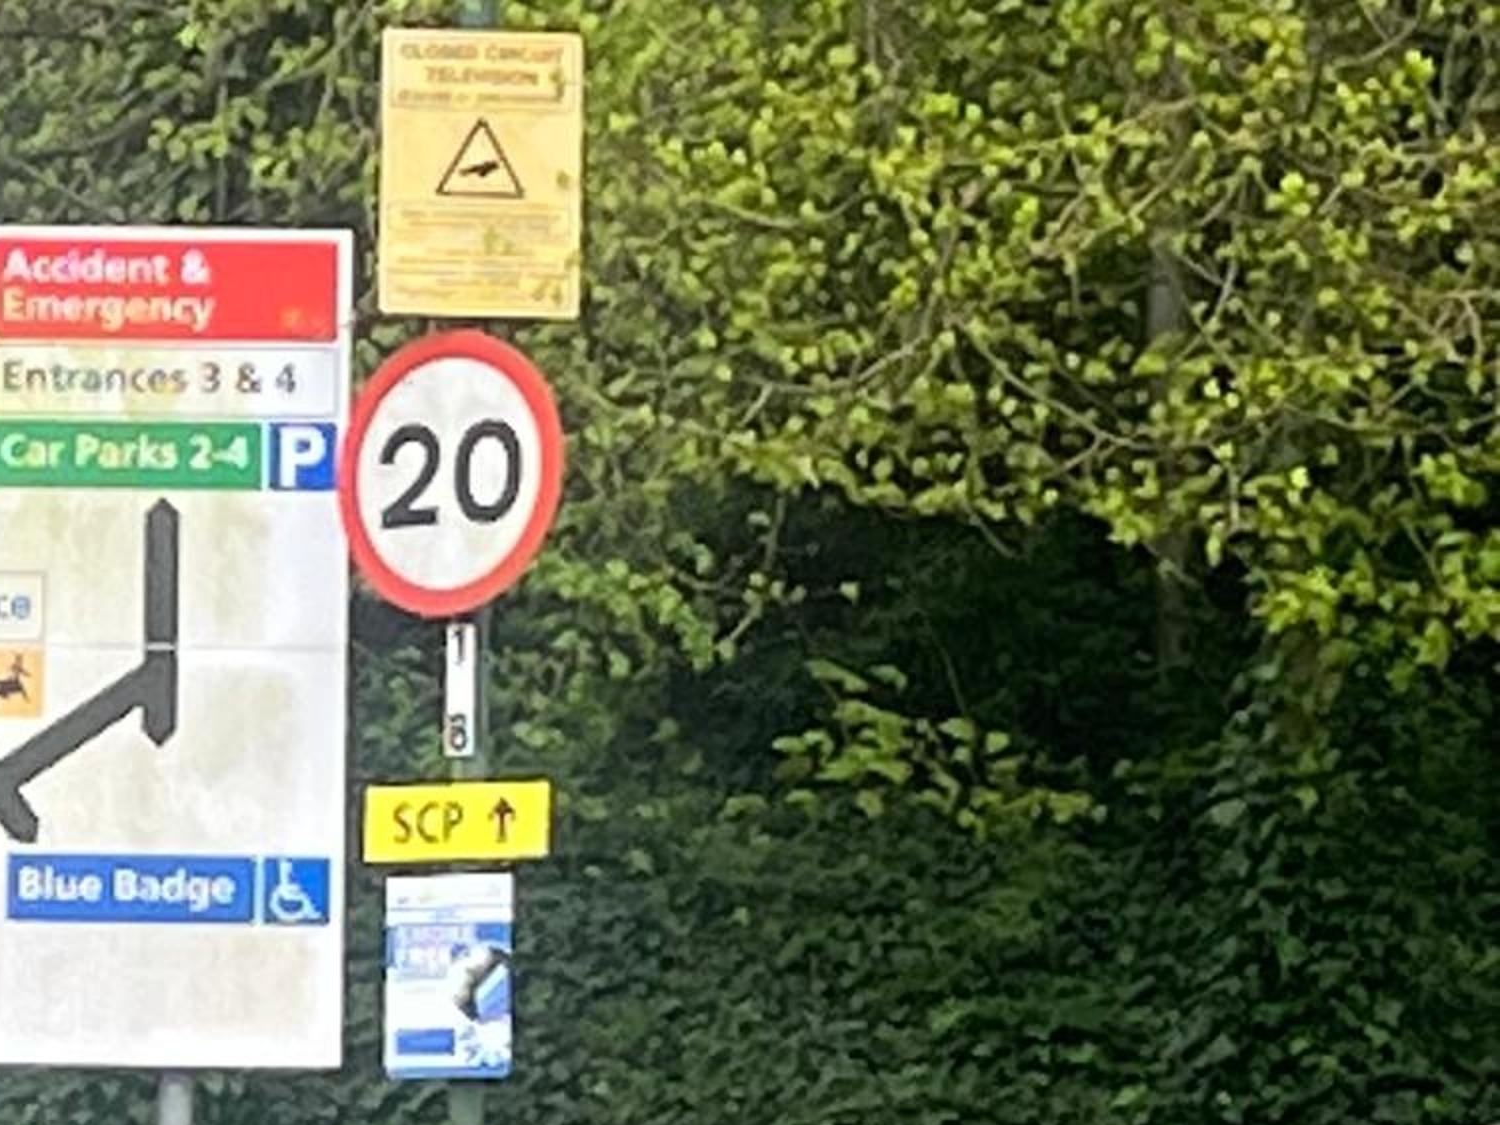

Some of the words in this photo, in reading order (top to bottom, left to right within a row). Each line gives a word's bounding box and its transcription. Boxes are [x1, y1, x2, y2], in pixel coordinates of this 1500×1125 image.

[3, 249, 170, 283] Accident
[180, 249, 211, 284] &
[2, 286, 215, 331] Emergency
[3, 360, 187, 394] Entrances
[200, 362, 220, 393] 3
[236, 363, 261, 393] &
[275, 362, 297, 393] 4
[0, 433, 65, 468] Car
[74, 433, 179, 469] Parks
[189, 434, 249, 470] 2-4
[278, 426, 326, 487] P
[379, 418, 522, 529] 20
[393, 801, 464, 844] SCP
[18, 865, 102, 901] Blue
[113, 866, 236, 912] Badge
